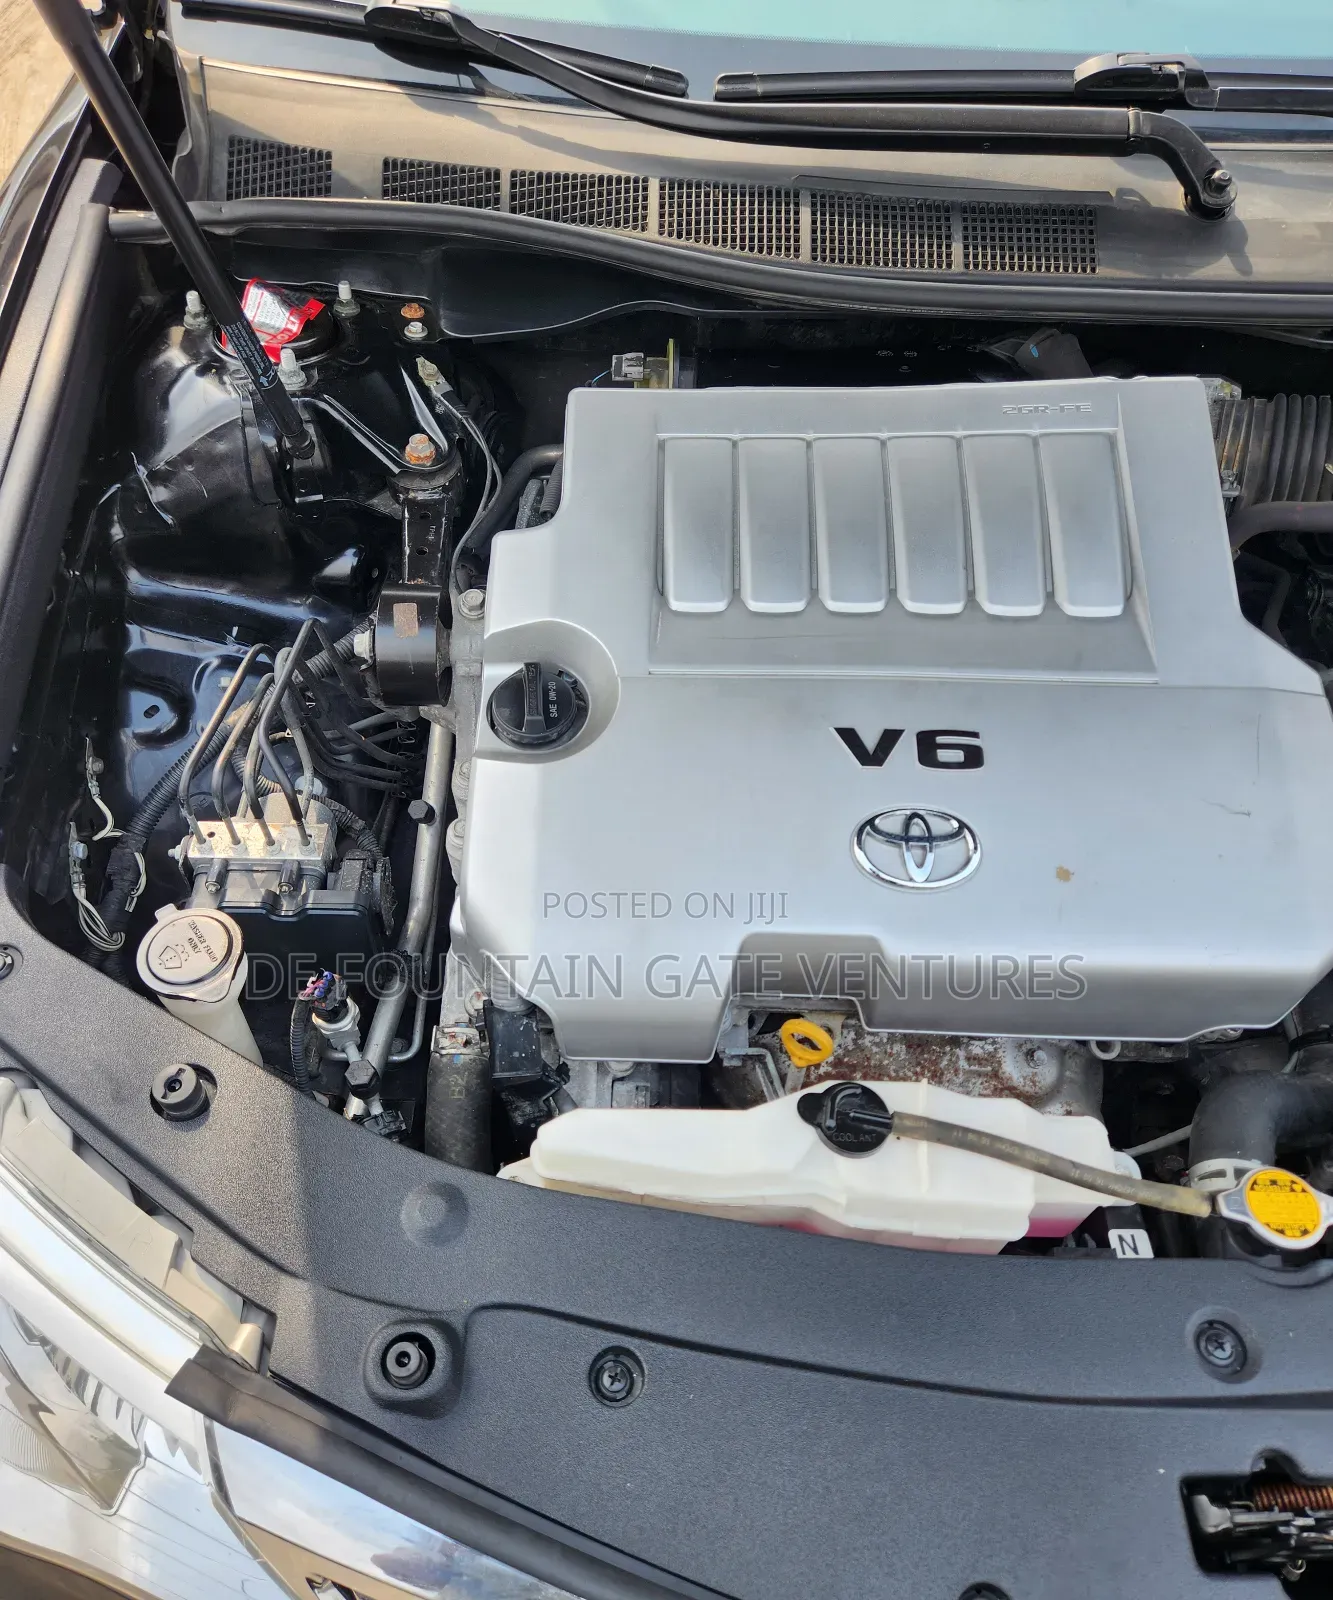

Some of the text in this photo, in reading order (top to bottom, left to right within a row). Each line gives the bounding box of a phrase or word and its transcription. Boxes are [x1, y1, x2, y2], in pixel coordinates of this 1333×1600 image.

[1002, 402, 1092, 415] 2GR-FE
[547, 681, 558, 718] SAE 0W-20
[829, 727, 985, 771] V6
[832, 1132, 877, 1142] COOLANT
[1117, 1234, 1140, 1255] N
